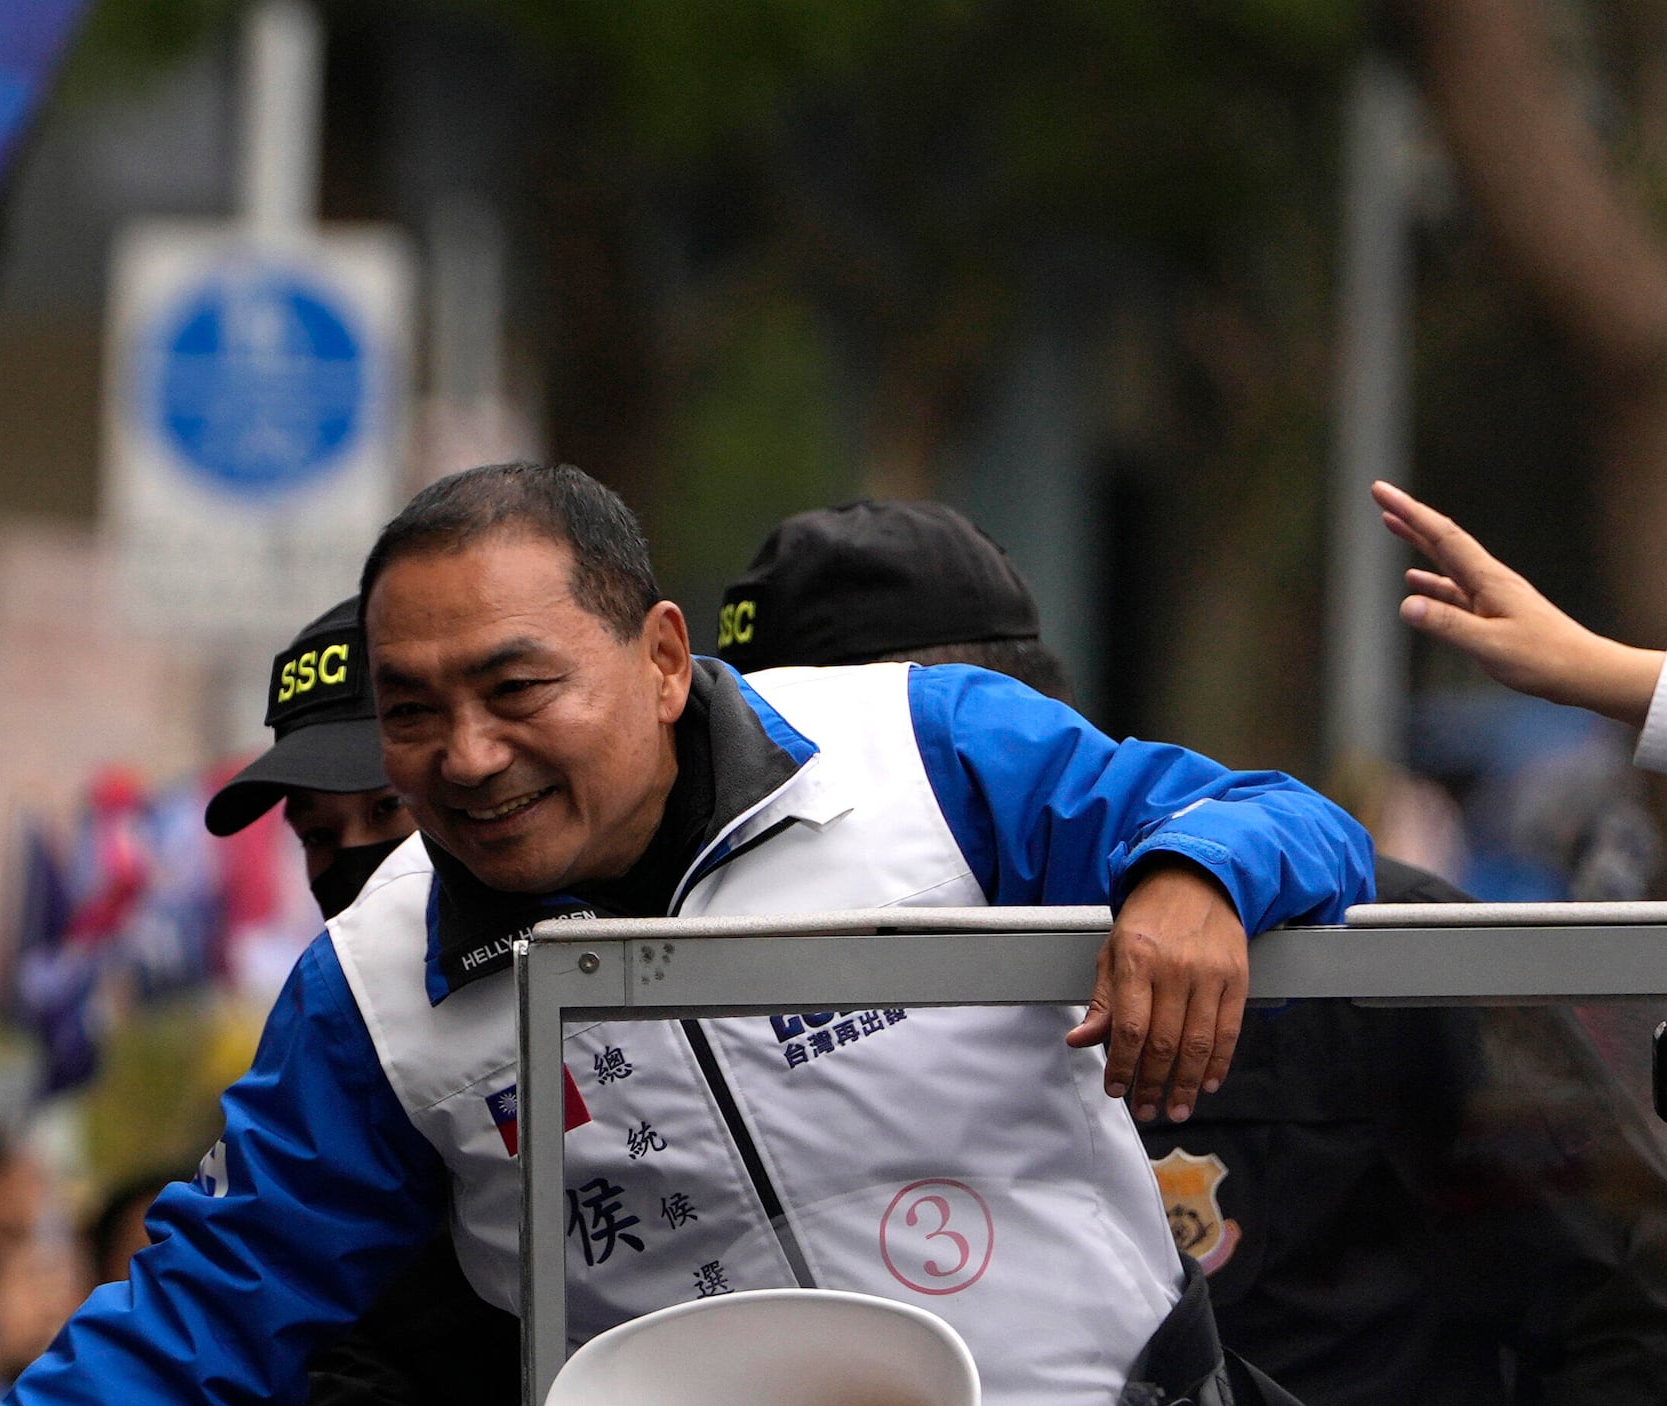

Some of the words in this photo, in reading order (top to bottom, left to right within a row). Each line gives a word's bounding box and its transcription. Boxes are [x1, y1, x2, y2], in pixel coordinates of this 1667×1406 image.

[277, 643, 350, 703] SSC
[462, 934, 515, 971] HELLY
[565, 1177, 646, 1268] 侯
